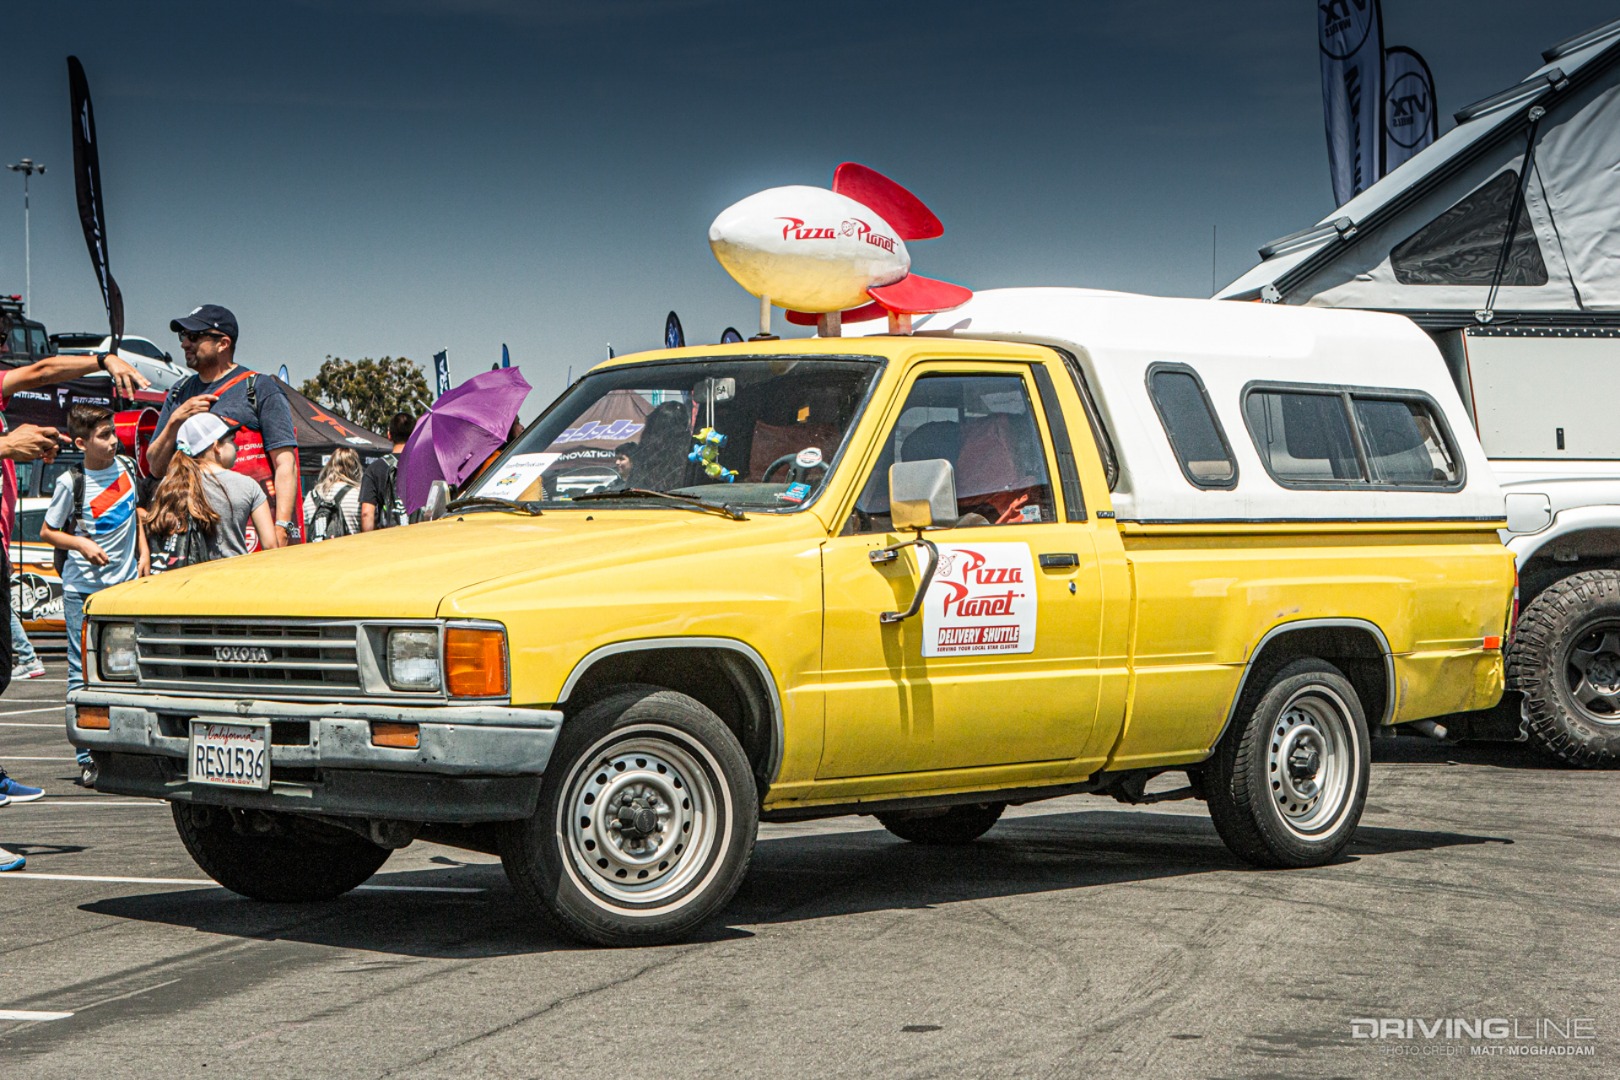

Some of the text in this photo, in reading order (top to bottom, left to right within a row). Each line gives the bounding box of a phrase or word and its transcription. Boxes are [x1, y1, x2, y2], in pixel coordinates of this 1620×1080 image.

[774, 216, 899, 254] Pizza Planet
[557, 450, 616, 461] NNOVATION
[951, 549, 1024, 585] Pizza
[935, 580, 1025, 617] Planet
[939, 625, 1020, 644] DELIVERY SHUTTLE
[213, 647, 268, 661] TOYOTA
[207, 726, 256, 745] California
[196, 745, 264, 779] RES1536
[210, 777, 251, 785] dmv.ca.gov
